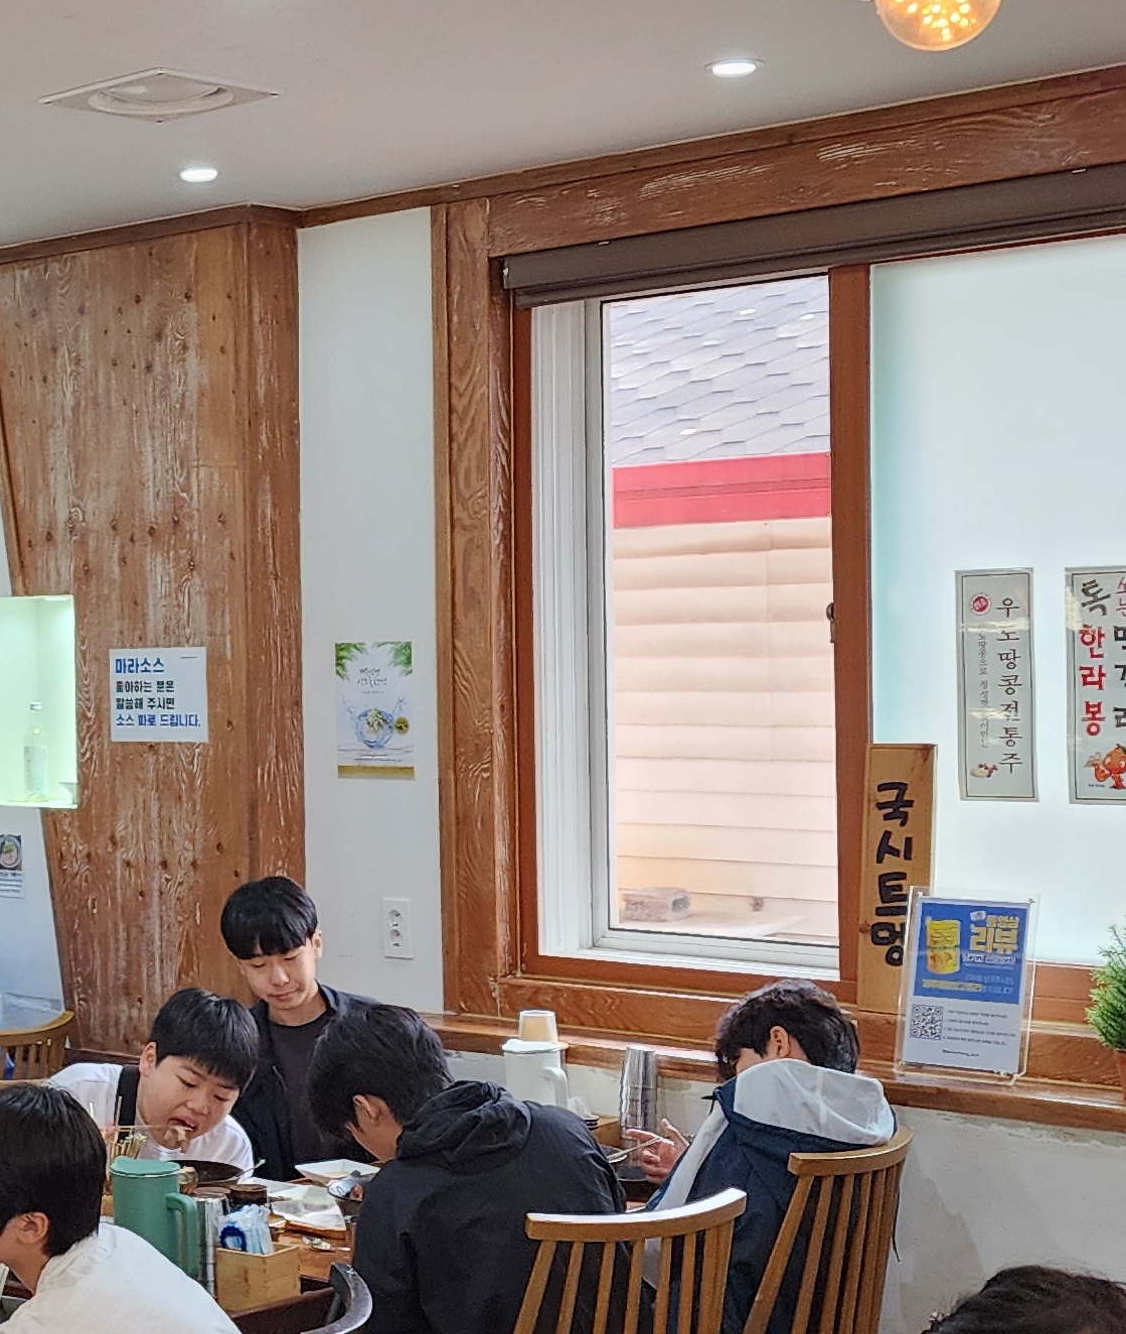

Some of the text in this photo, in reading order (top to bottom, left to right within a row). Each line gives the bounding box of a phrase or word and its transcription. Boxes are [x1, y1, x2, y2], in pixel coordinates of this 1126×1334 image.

[115, 657, 164, 674] 마라소스
[156, 680, 175, 693] 분은
[1078, 623, 1107, 737] 한라봉
[147, 697, 176, 710] 주시면
[116, 714, 202, 728] 소스 따로 드립니다.
[969, 923, 1019, 955] 리뷰
